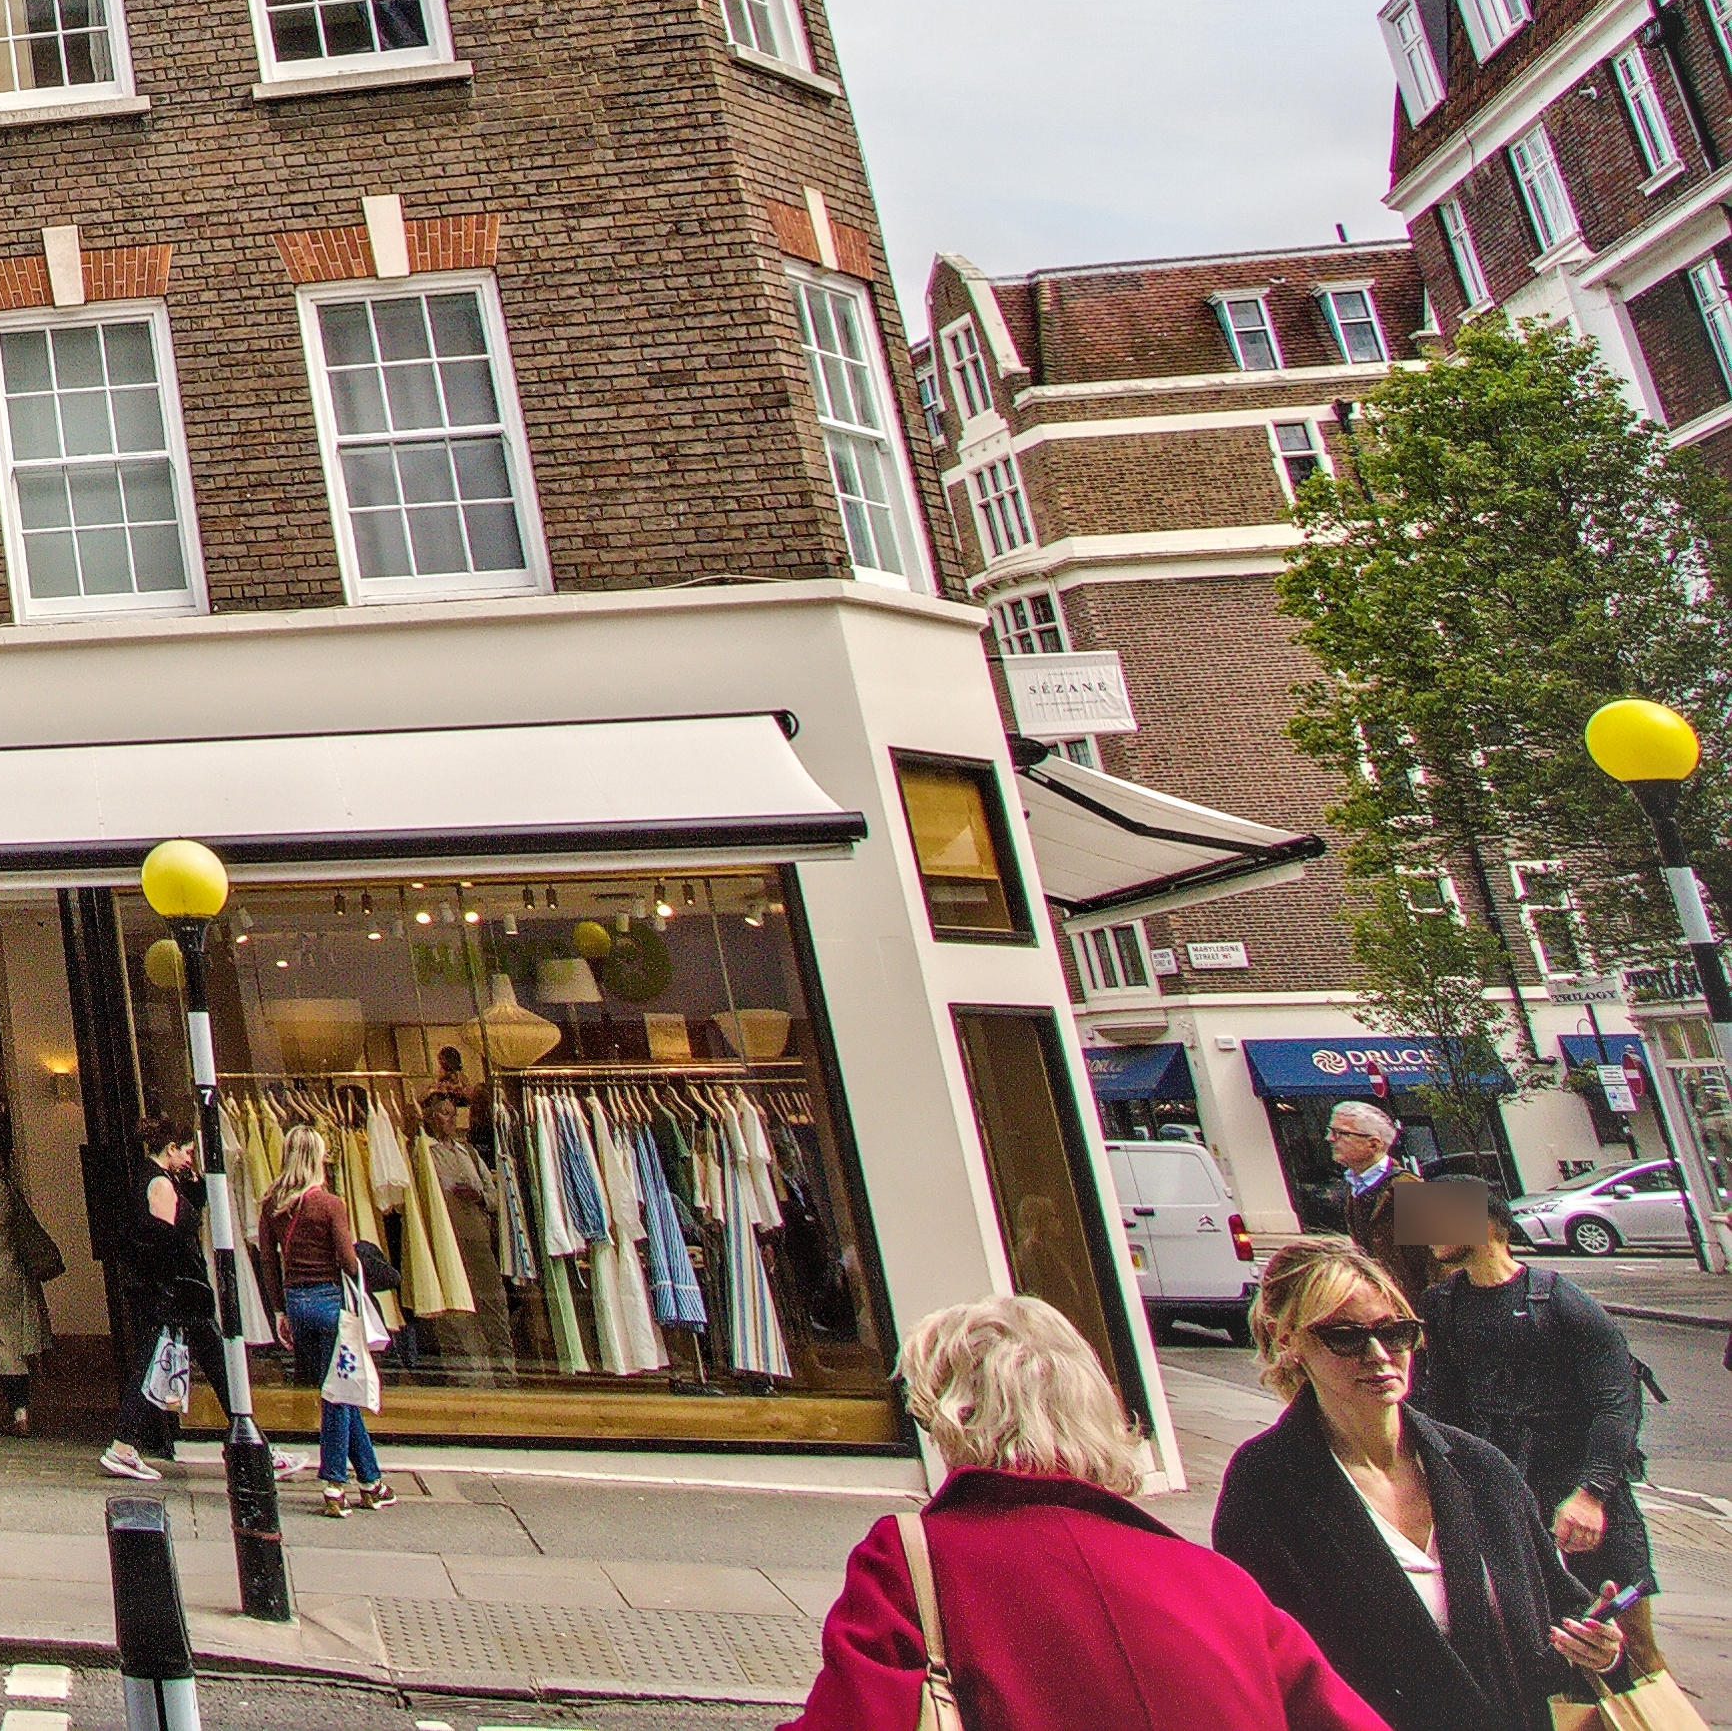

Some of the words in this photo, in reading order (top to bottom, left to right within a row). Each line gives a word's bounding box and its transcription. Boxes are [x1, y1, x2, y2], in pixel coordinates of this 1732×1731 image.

[1028, 681, 1108, 695] SÉZANE
[1194, 952, 1220, 960] STREET
[200, 1089, 214, 1106] 7
